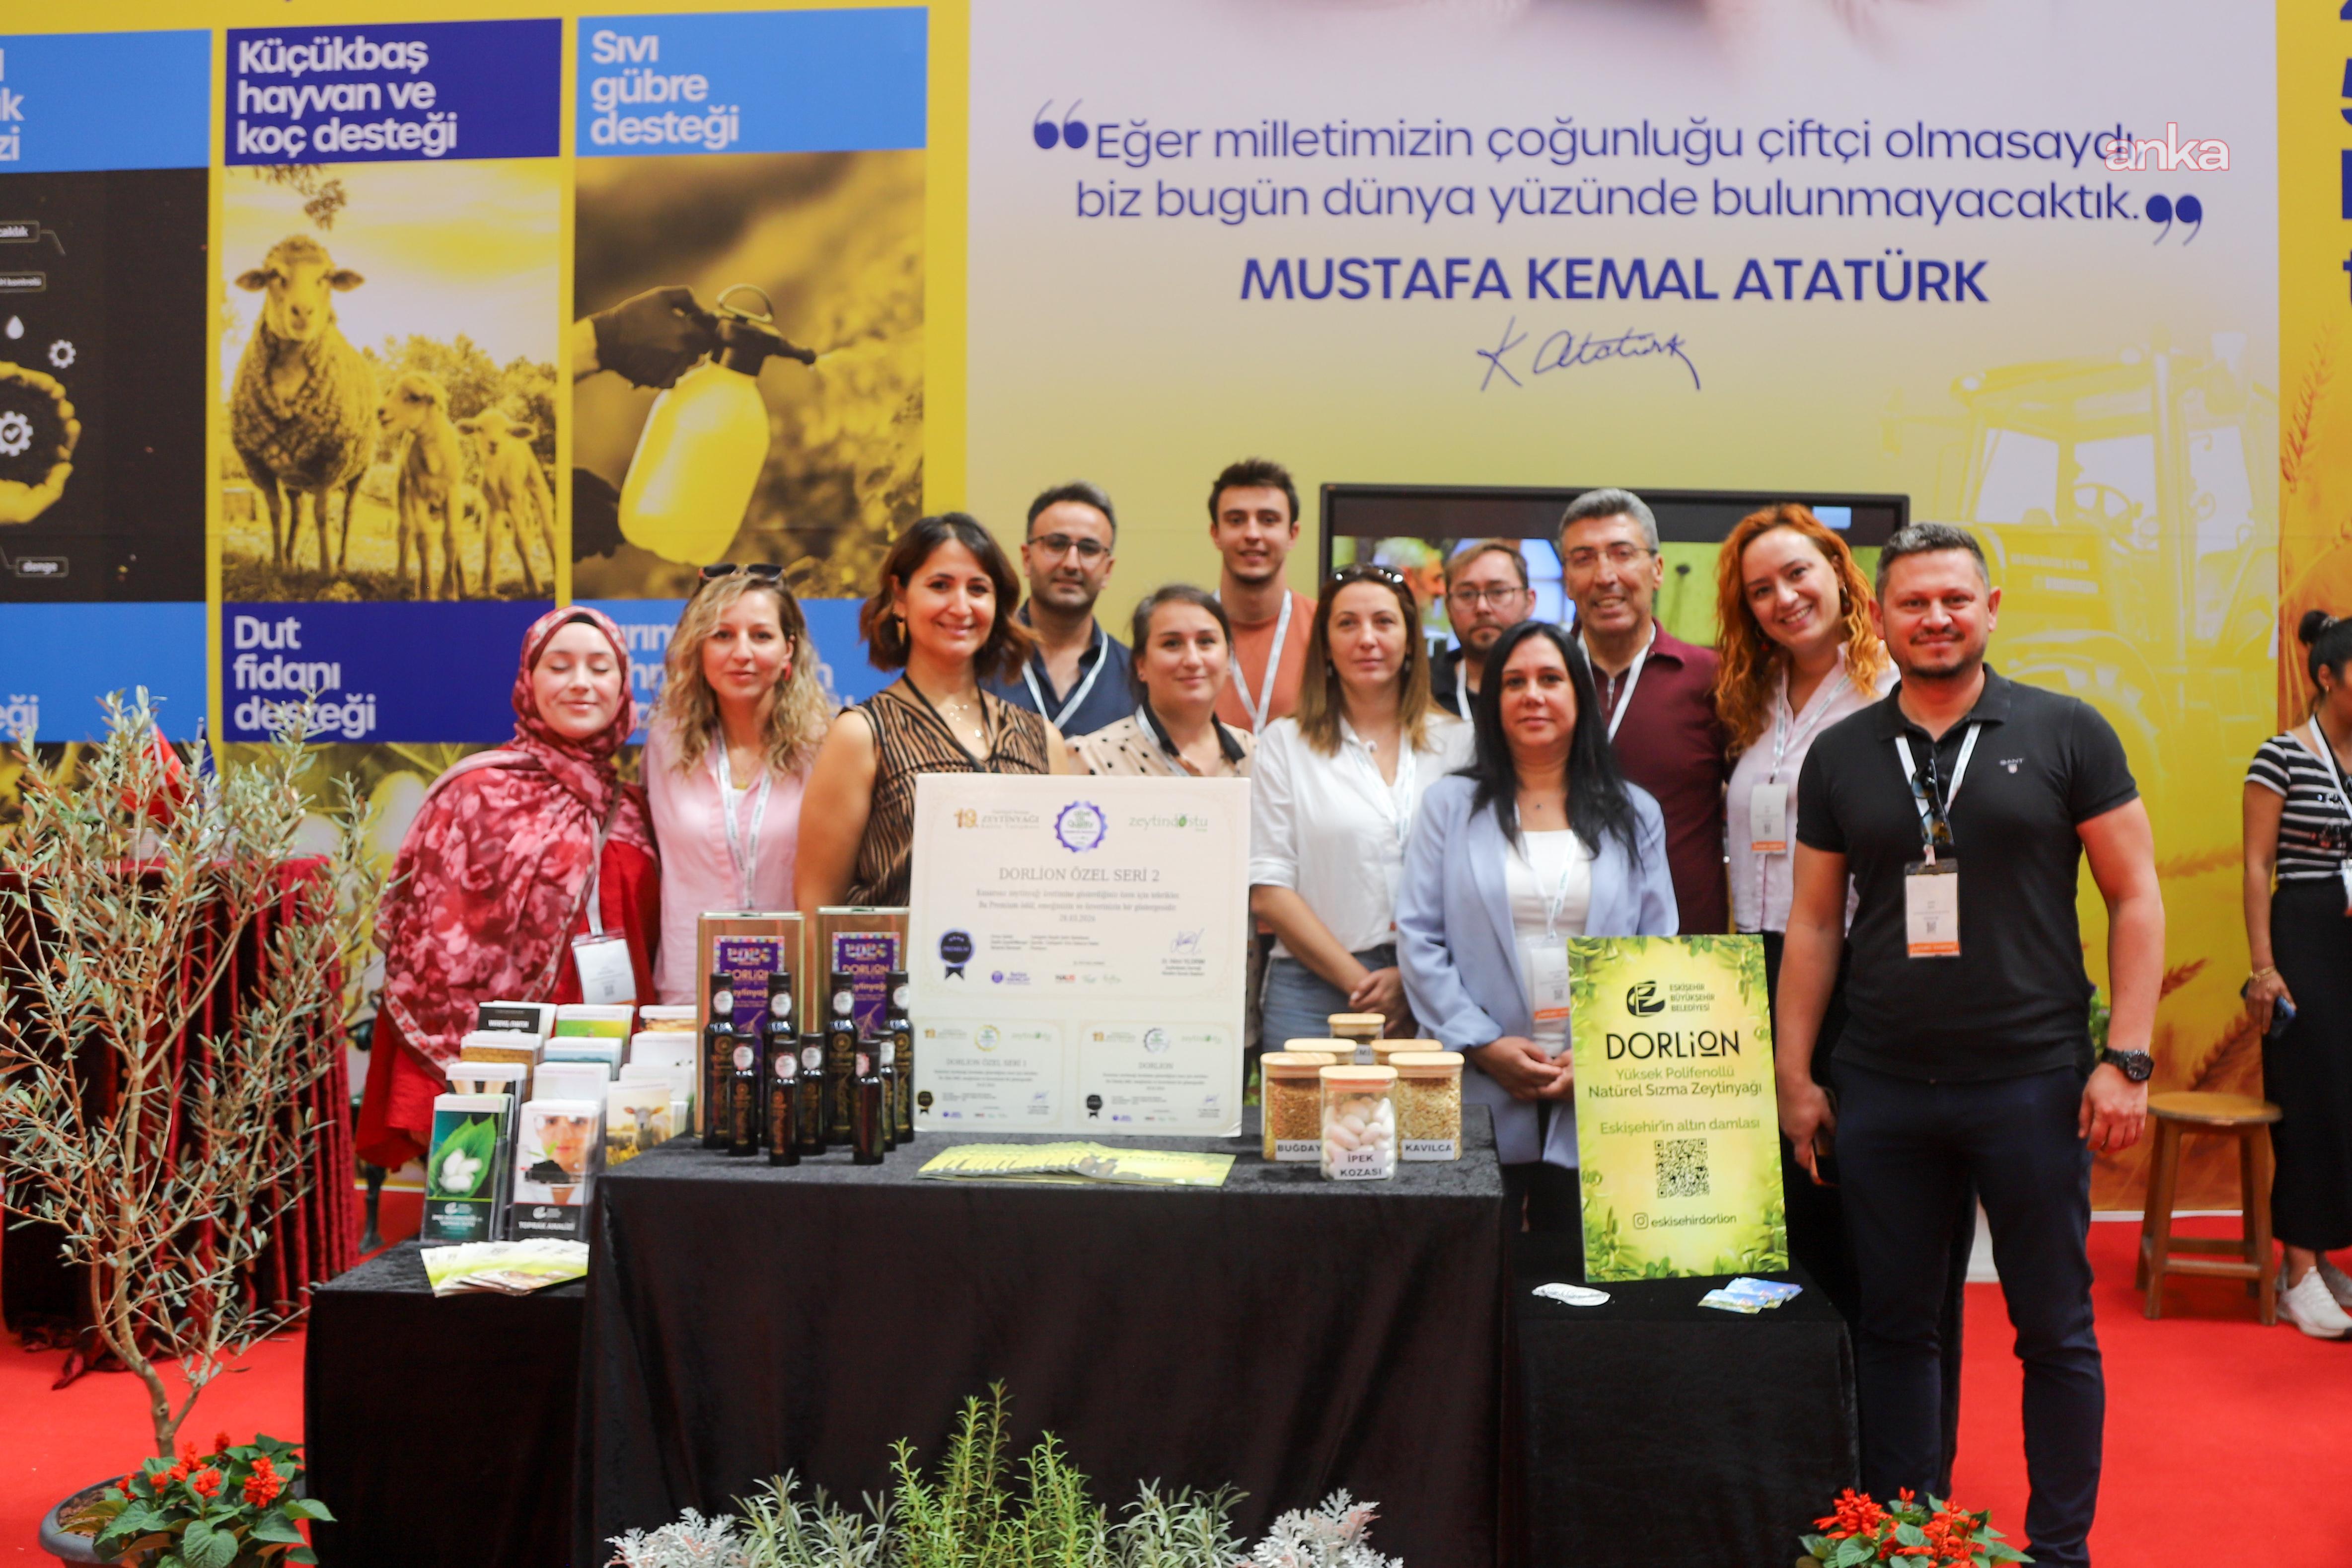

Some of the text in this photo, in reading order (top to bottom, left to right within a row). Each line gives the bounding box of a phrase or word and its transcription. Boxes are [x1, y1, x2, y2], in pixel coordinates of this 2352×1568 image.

[238, 35, 430, 77] Küçükbaş
[591, 29, 660, 65] Sıvı
[237, 79, 437, 121] hayvan ve
[590, 67, 709, 113] gübre
[236, 111, 458, 158] koç desteği
[590, 104, 740, 150] desteği
[1097, 118, 1201, 168] Eğer
[1215, 119, 1473, 158] milletimizin
[1487, 115, 1744, 166] çoğunluğu
[1758, 119, 1871, 164] çiftçi
[1077, 177, 2139, 226] biz bugün dünya yüzünde bulunmayacaktık.
[1240, 248, 1989, 302] MUSTAFA KEMAL ATATÜRK
[233, 615, 301, 650] Dut
[233, 653, 342, 691] fidanı
[1070, 866, 1109, 882] ÖZEL
[1113, 867, 1147, 883] SERİ
[1151, 869, 1160, 883] 2
[1589, 1080, 1763, 1098] Natürel Sızma Zeytinyağı
[1616, 1066, 1735, 1080] Yüksek Polifenollü
[1677, 1119, 1706, 1132] altın
[1708, 1118, 1760, 1130] damlası
[1277, 1143, 1321, 1153] BUĞDAY
[1347, 1152, 1373, 1163] İPEK
[1405, 1144, 1452, 1153] KAVILCA
[1340, 1167, 1382, 1178] KOZASI
[1651, 1213, 1737, 1228] eskisehirdorlion
